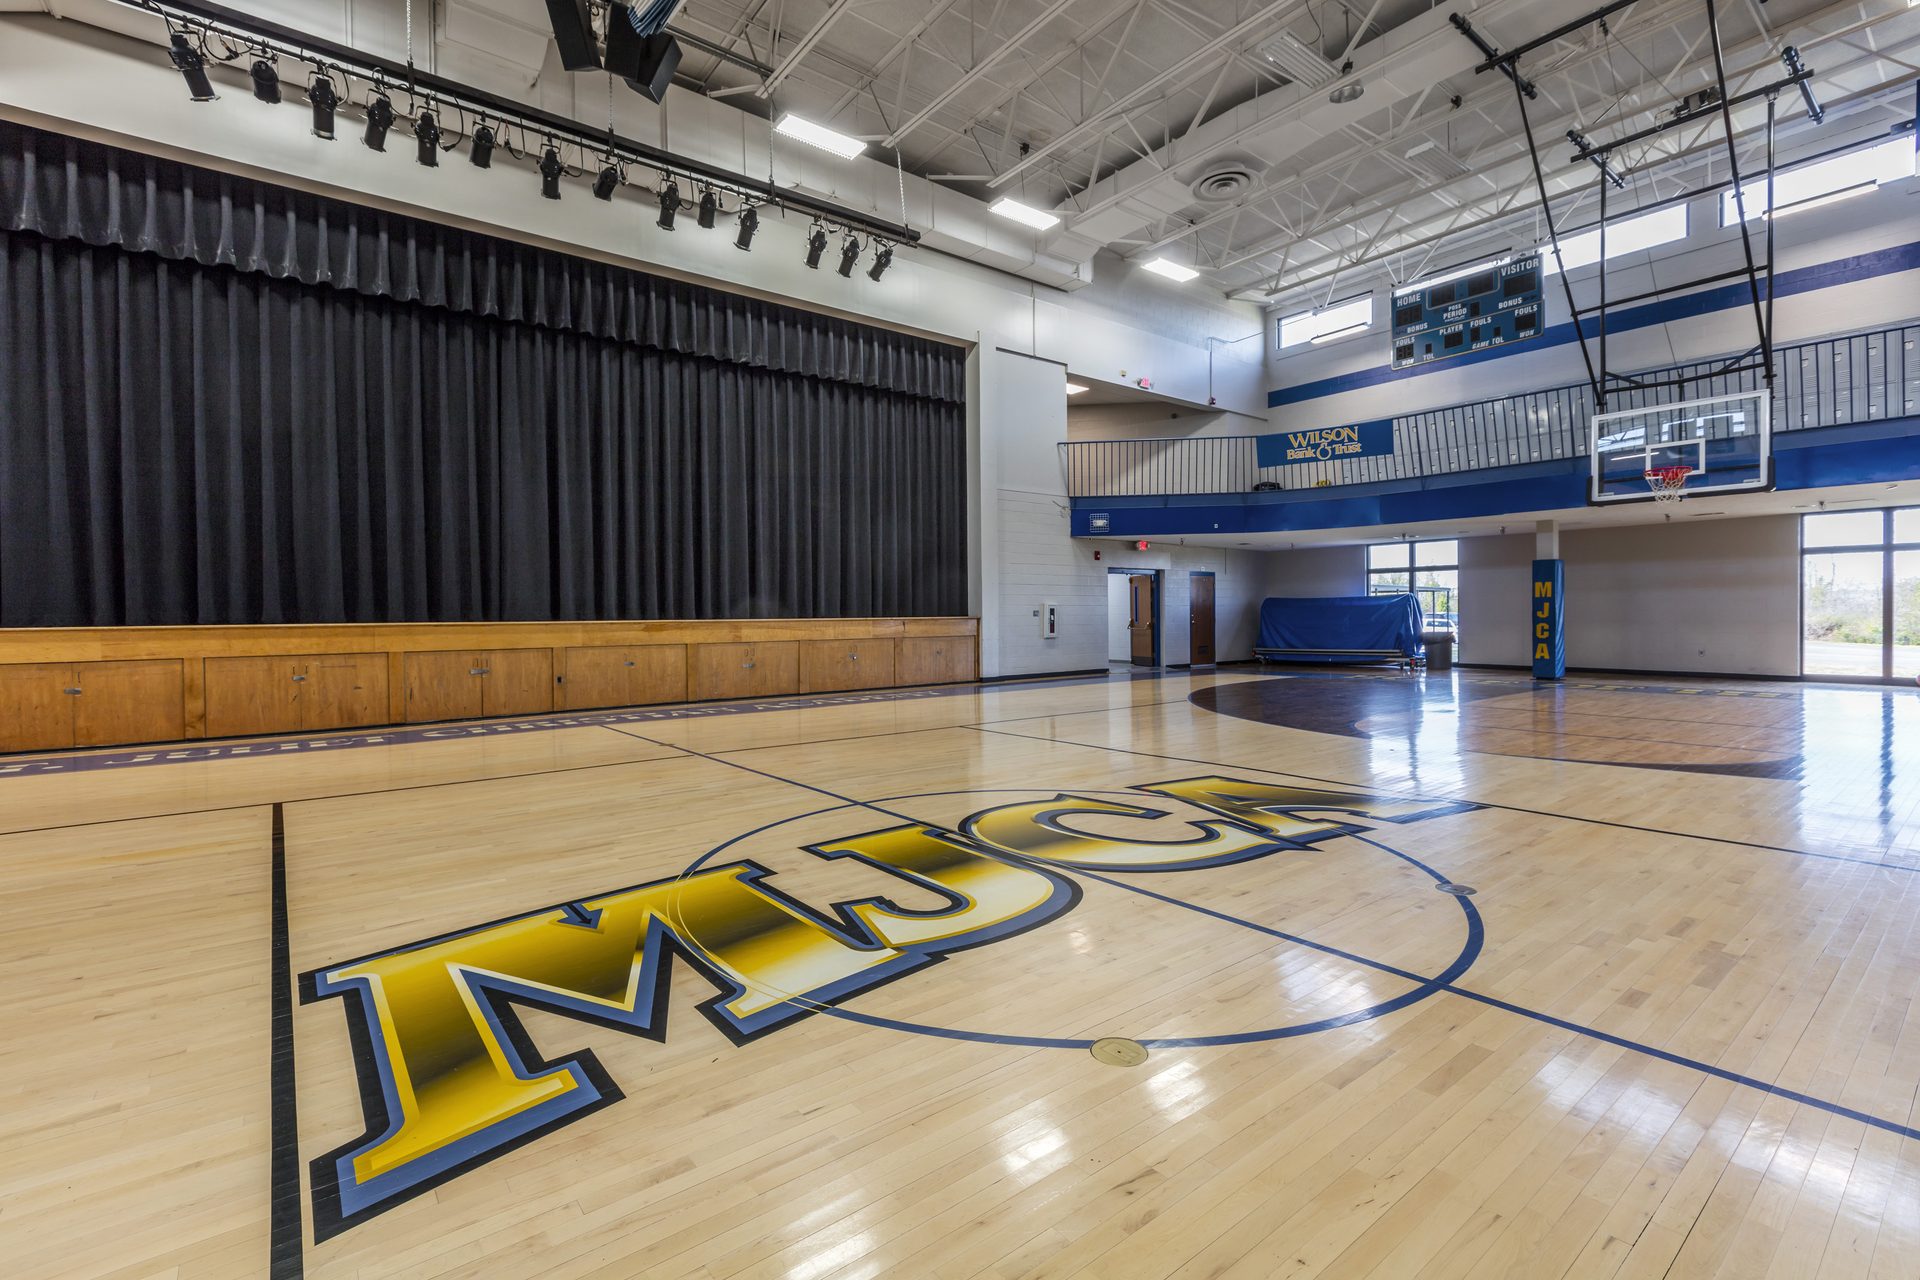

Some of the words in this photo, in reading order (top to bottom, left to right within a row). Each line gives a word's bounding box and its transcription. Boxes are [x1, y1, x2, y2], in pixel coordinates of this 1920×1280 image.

[1501, 258, 1540, 277] VISITOR
[1397, 292, 1421, 307] HOME
[1498, 297, 1523, 310] BONUS
[1443, 307, 1467, 320] PERIOD
[1514, 304, 1538, 317] FOULS
[1407, 322, 1428, 334] BONUS
[1470, 316, 1492, 328] FOULS
[1439, 323, 1464, 336] PLAYER
[1519, 329, 1535, 338] WON
[1396, 336, 1416, 346] FOULS
[1401, 358, 1415, 366] WON
[1288, 426, 1358, 448] WILSON
[1287, 448, 1317, 460] Bank
[1317, 442, 1332, 460] &
[1333, 443, 1362, 455] Trust
[1534, 581, 1552, 660] MJCA
[299, 776, 1489, 1245] MJCA
